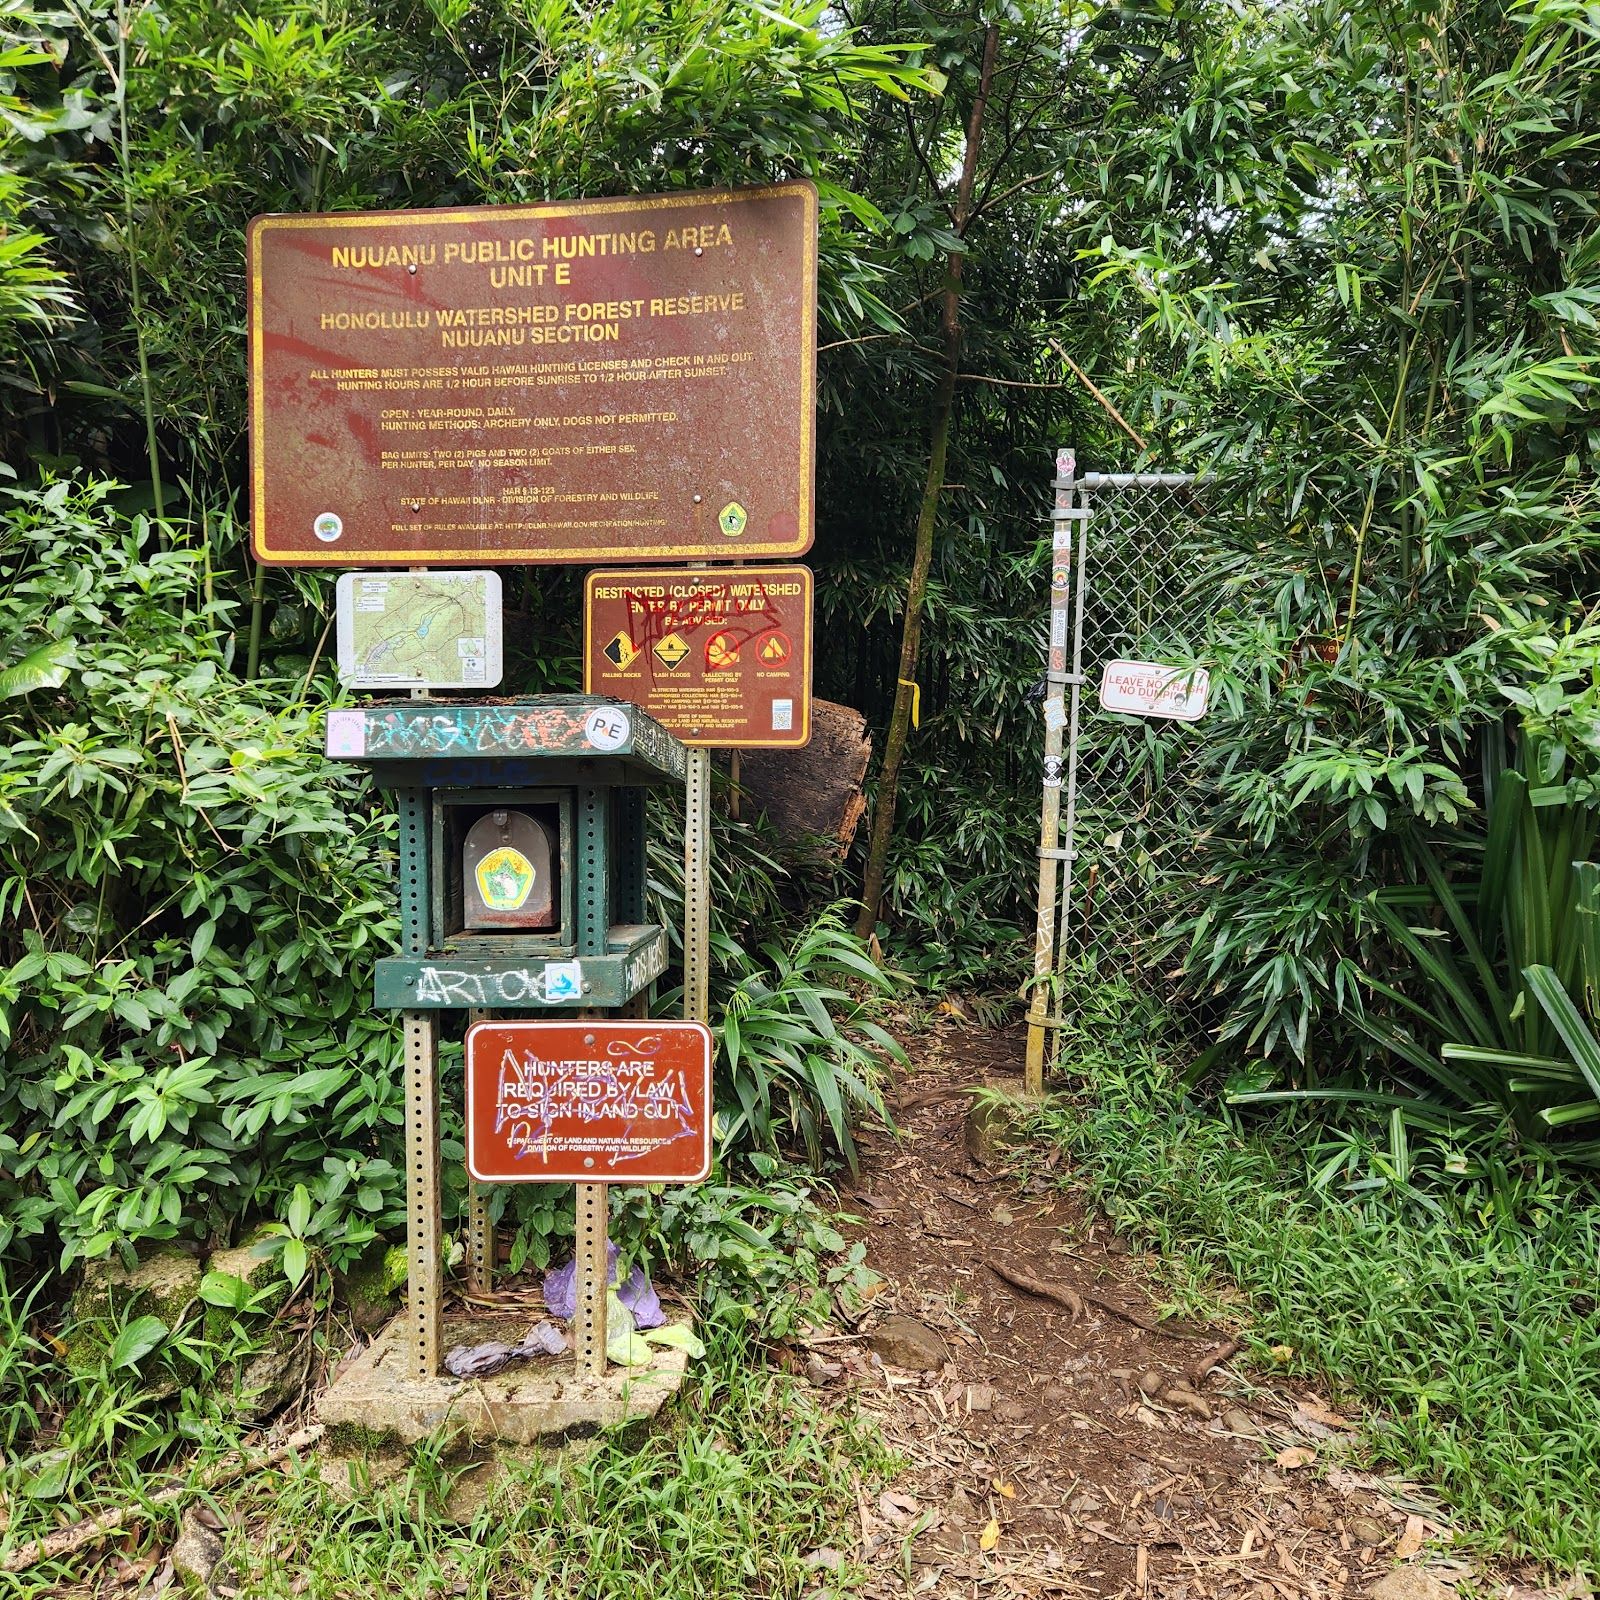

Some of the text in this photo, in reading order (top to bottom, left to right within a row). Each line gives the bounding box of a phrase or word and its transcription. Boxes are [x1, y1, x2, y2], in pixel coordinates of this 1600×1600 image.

[332, 223, 733, 268] NUUANU PUBLIC HUNTING AREA
[490, 263, 571, 289] UNIT E
[320, 292, 744, 330] HONOLULU WATERSHED FOREST RESERVE
[442, 323, 619, 348] NUUANU SECTION
[310, 370, 330, 380] ALL
[331, 368, 379, 379] HUNTERS
[381, 367, 409, 378] MUST
[412, 366, 458, 377] POSSESS
[461, 365, 489, 376] VALID
[491, 364, 528, 375] HAWAII
[530, 362, 575, 374] HUNTING
[578, 360, 627, 371] LICENSES
[630, 358, 652, 369] AND
[654, 357, 691, 368] CHECK
[693, 355, 704, 366] IN
[707, 354, 729, 365] AND
[337, 367, 727, 391] HUNTING HOURS ARE 1/2 HOUR BEFORE SUNRISE TO 1/2 HOUR AFTER SUNSET.
[381, 406, 515, 419] OPEN YEAR-ROUND, DAILY.
[381, 412, 679, 431] HUNTING METHODS: ARCHERY ONLY, DOGS NOT PERMITTED.
[381, 451, 400, 460] BAG
[401, 450, 431, 460] LIMITS:
[432, 450, 452, 460] TWO
[453, 450, 465, 460] (2)
[466, 449, 486, 459] PIGS
[488, 449, 506, 458] AND
[507, 448, 528, 458] TWO
[529, 448, 540, 458] (2)
[542, 446, 571, 457] GOATS
[572, 446, 585, 456] OF
[586, 445, 617, 455] EITHER
[381, 457, 553, 470] PER HUNTER, PER DAY. NO SEASON LIMIT.
[400, 491, 659, 506] STATE OF HAWAII DLNR DIVISION OF FORESTRY AND WILDLIFE
[502, 487, 521, 496] HAR
[391, 524, 408, 532] FULL
[409, 524, 422, 532] SET
[423, 524, 433, 532] OF
[434, 523, 456, 531] RULES
[457, 523, 492, 531] AVAILABLE
[595, 583, 801, 599] RESTRICTED (CLOSED) WATERSHED
[669, 600, 685, 612] BY
[689, 599, 732, 612] PERMIT
[735, 599, 766, 612] ONLY
[664, 616, 679, 626] BE
[1108, 675, 1144, 687] LEAVE
[1146, 679, 1163, 689] NO
[1119, 685, 1179, 700] NO DUMPI
[524, 1061, 655, 1077] HUNTERS ARE
[503, 1082, 675, 1099] REQUIRED BY LAW
[496, 1103, 681, 1119] TO SIGN IN AND OUT
